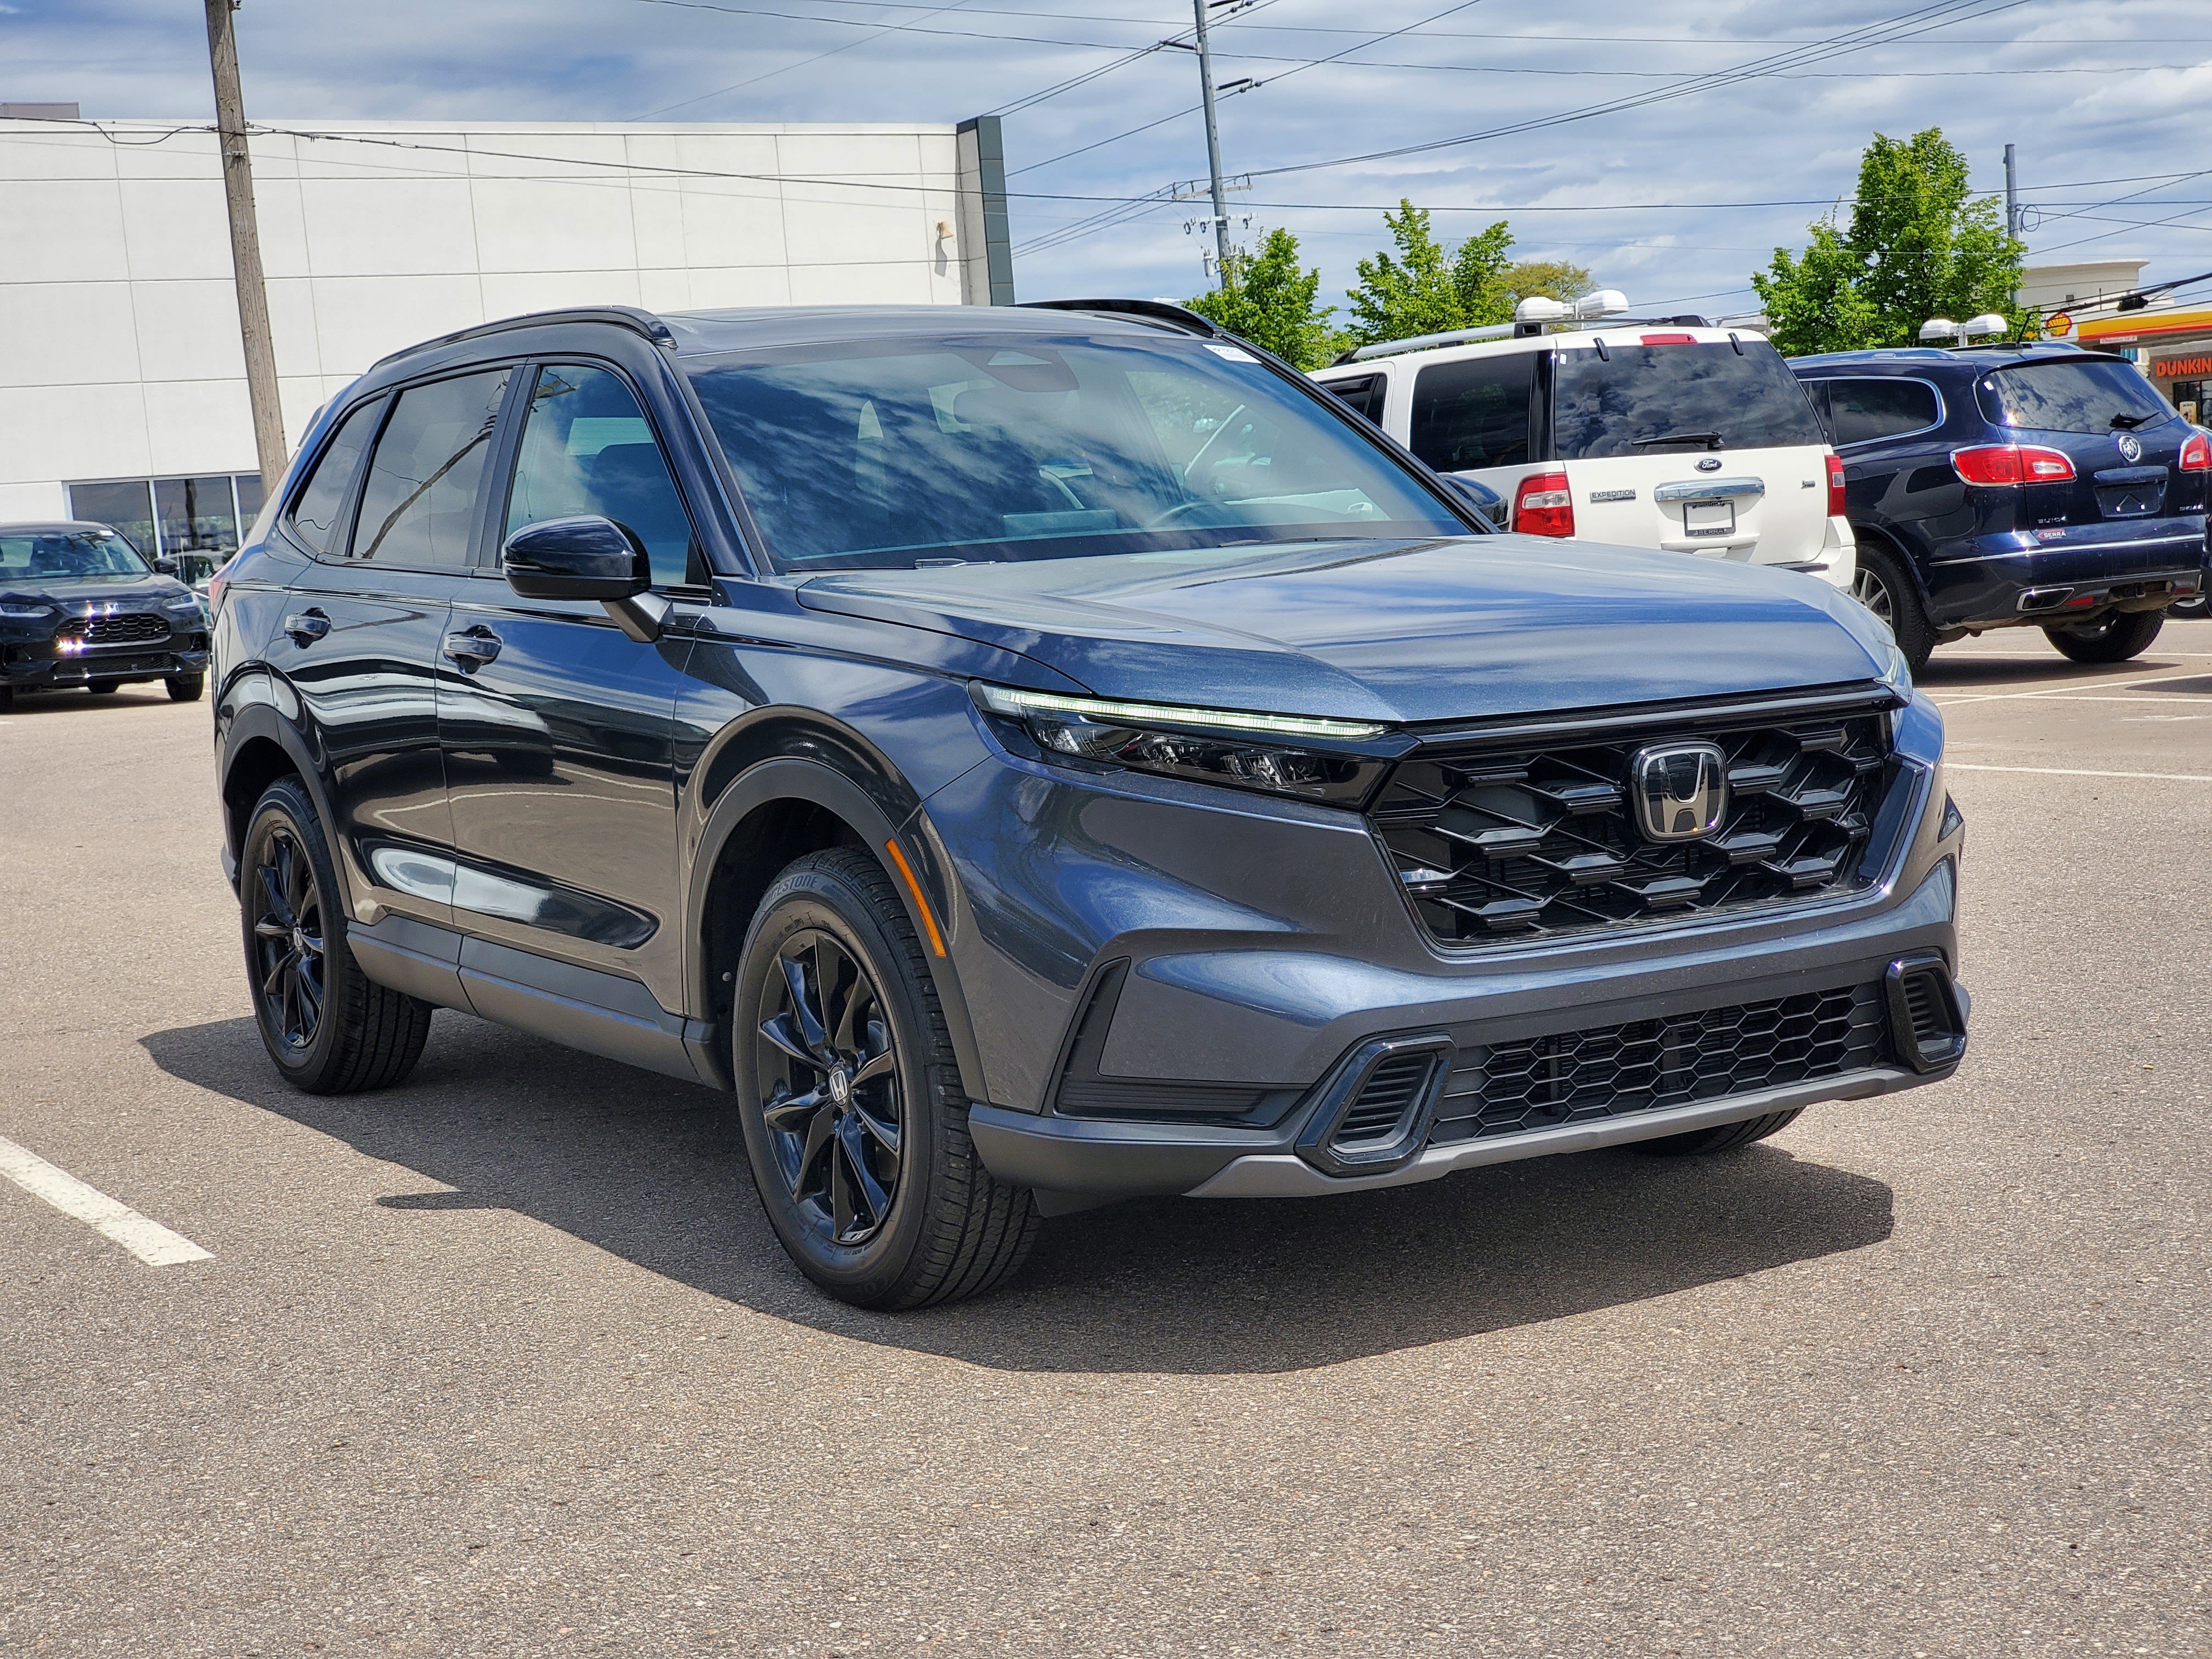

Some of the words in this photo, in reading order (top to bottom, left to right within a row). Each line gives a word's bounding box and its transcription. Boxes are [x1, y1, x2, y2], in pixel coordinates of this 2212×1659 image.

[2156, 357, 2212, 377] DUNKIN
[1702, 460, 1718, 469] Ford
[1592, 489, 1635, 498] EXPEDITION
